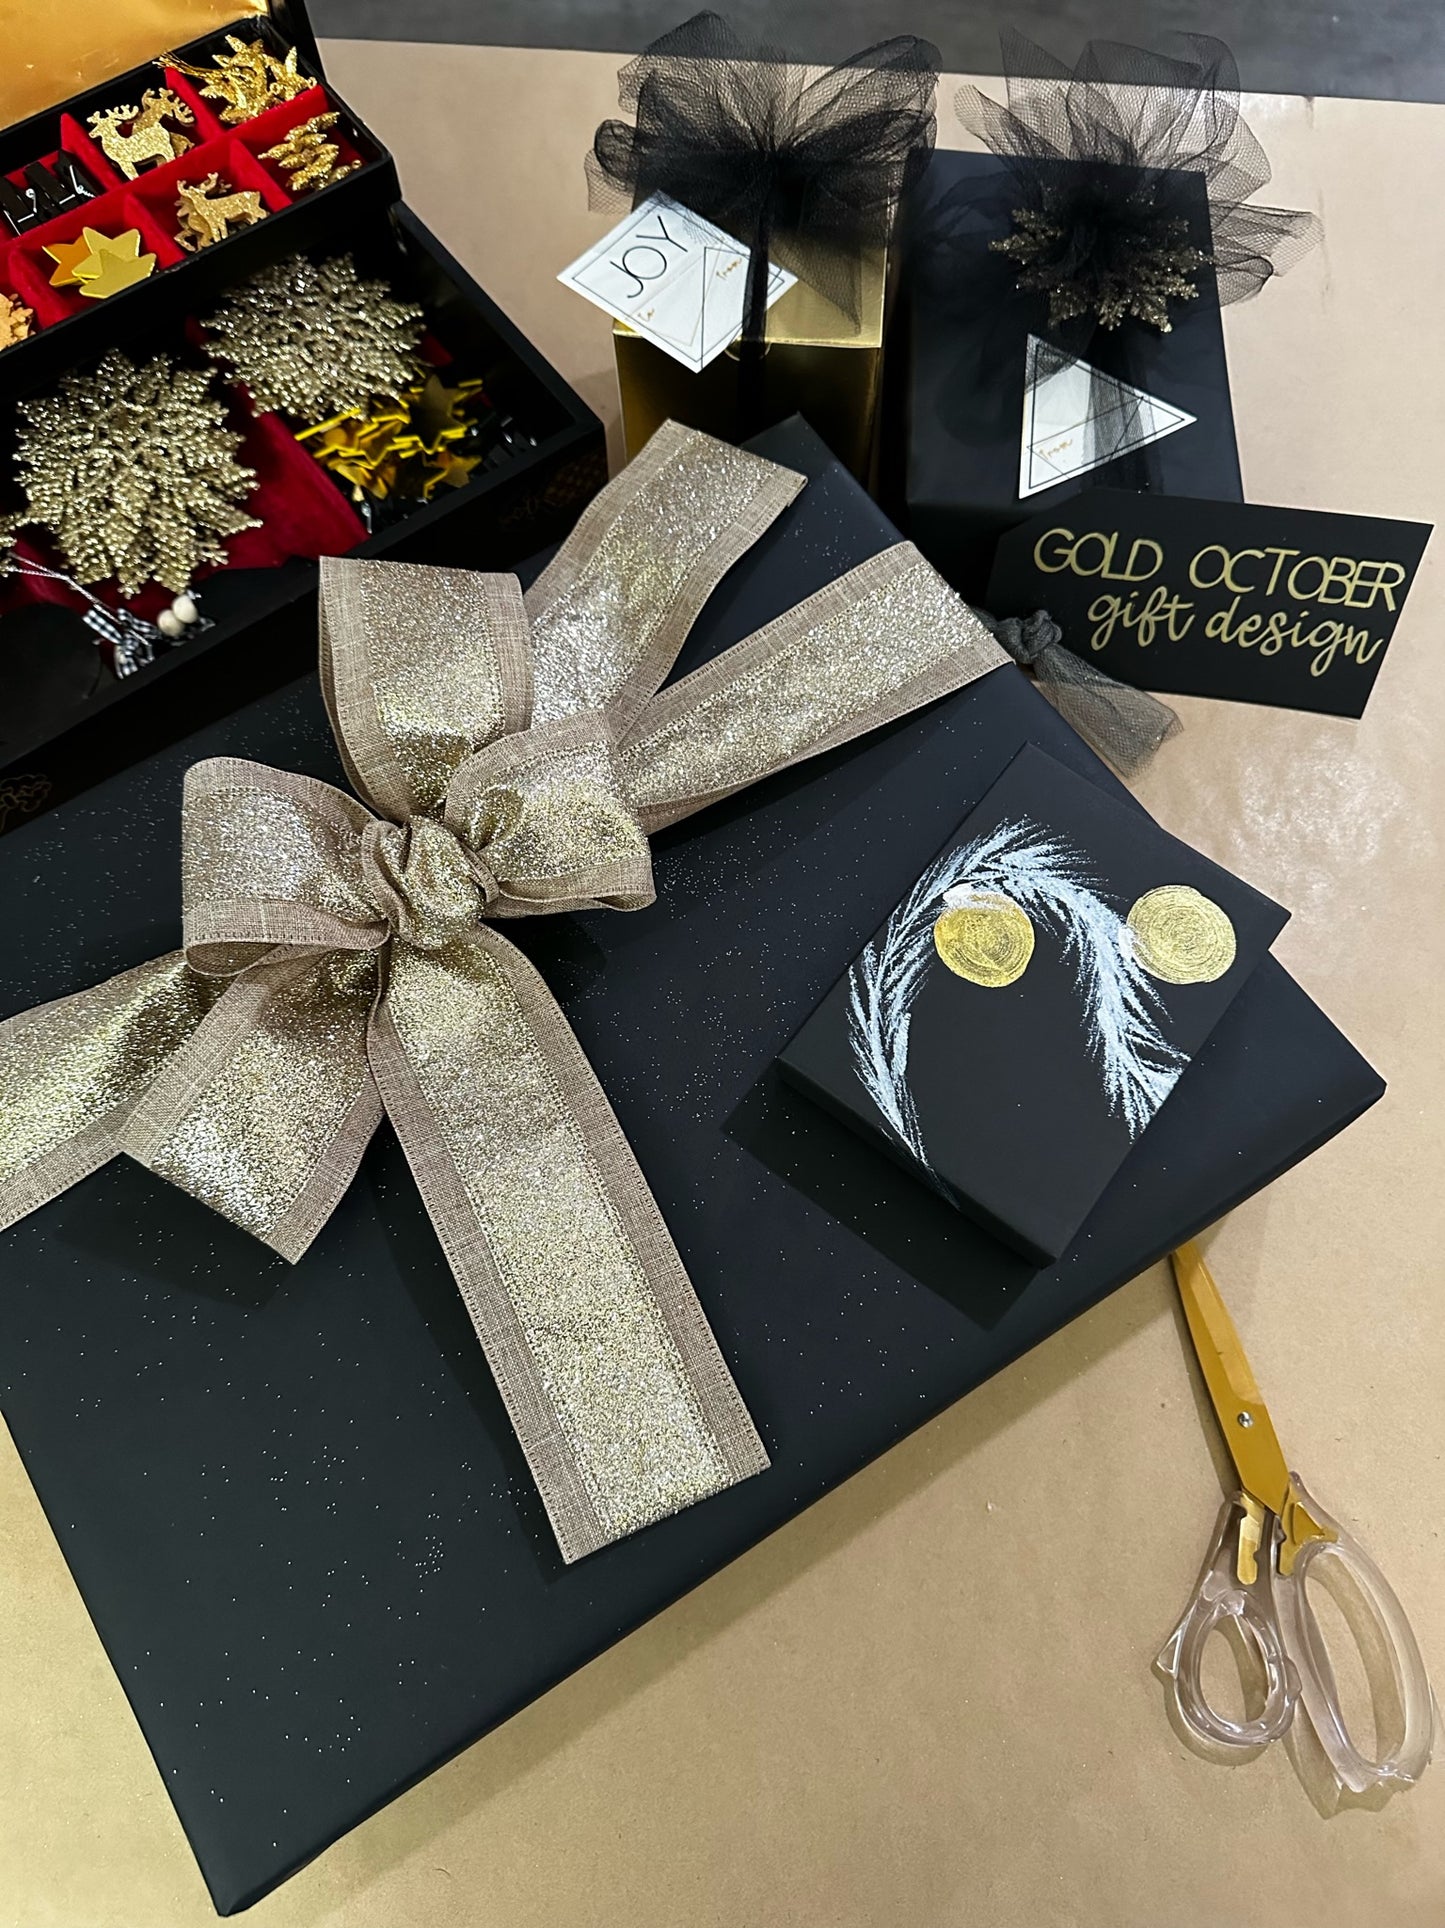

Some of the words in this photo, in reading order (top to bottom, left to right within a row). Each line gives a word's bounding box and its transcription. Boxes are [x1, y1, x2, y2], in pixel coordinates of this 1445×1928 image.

[609, 215, 689, 299] JOY
[1033, 527, 1164, 582] GOLD
[1188, 544, 1406, 612] OCTOBER
[1087, 585, 1197, 652] gift
[1204, 596, 1385, 678] design
